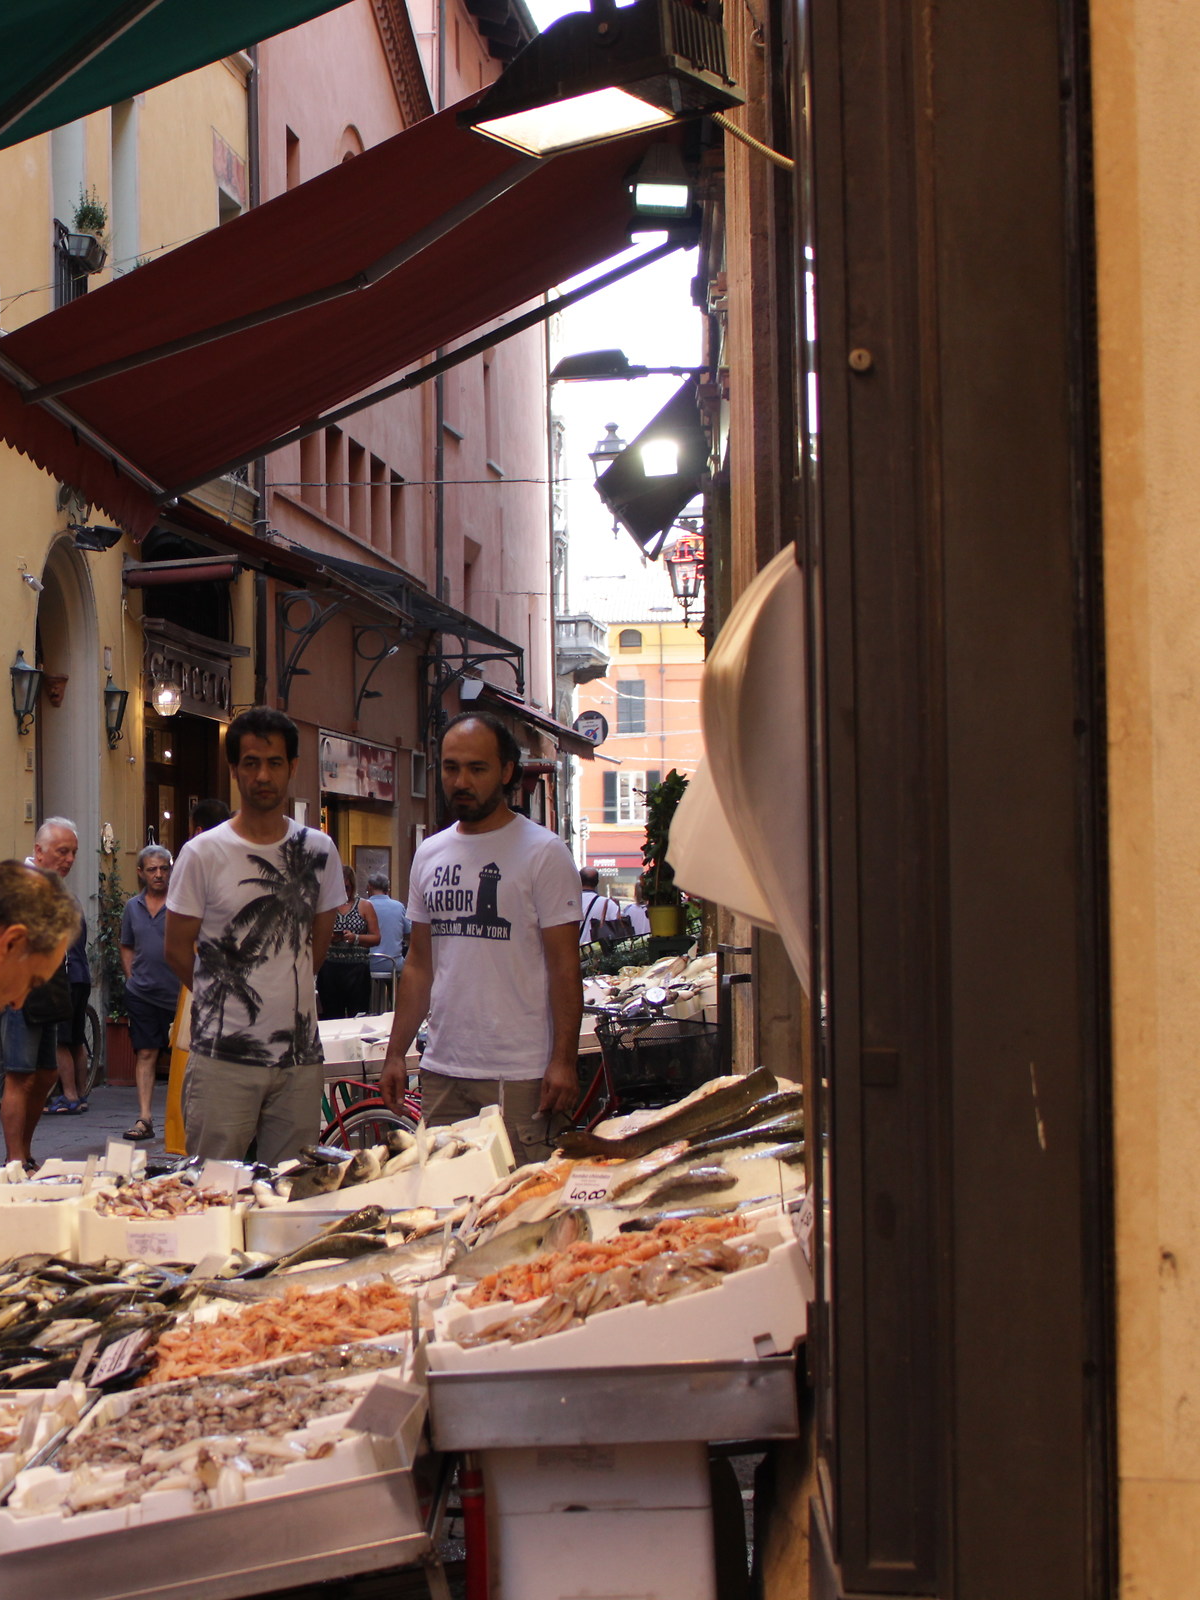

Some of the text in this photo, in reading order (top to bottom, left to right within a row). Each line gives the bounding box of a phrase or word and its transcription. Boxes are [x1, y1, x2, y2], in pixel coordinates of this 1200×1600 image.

[432, 864, 462, 888] SAG
[466, 923, 484, 937] NEW
[487, 925, 509, 939] YORK
[570, 1187, 607, 1202] 40,00
